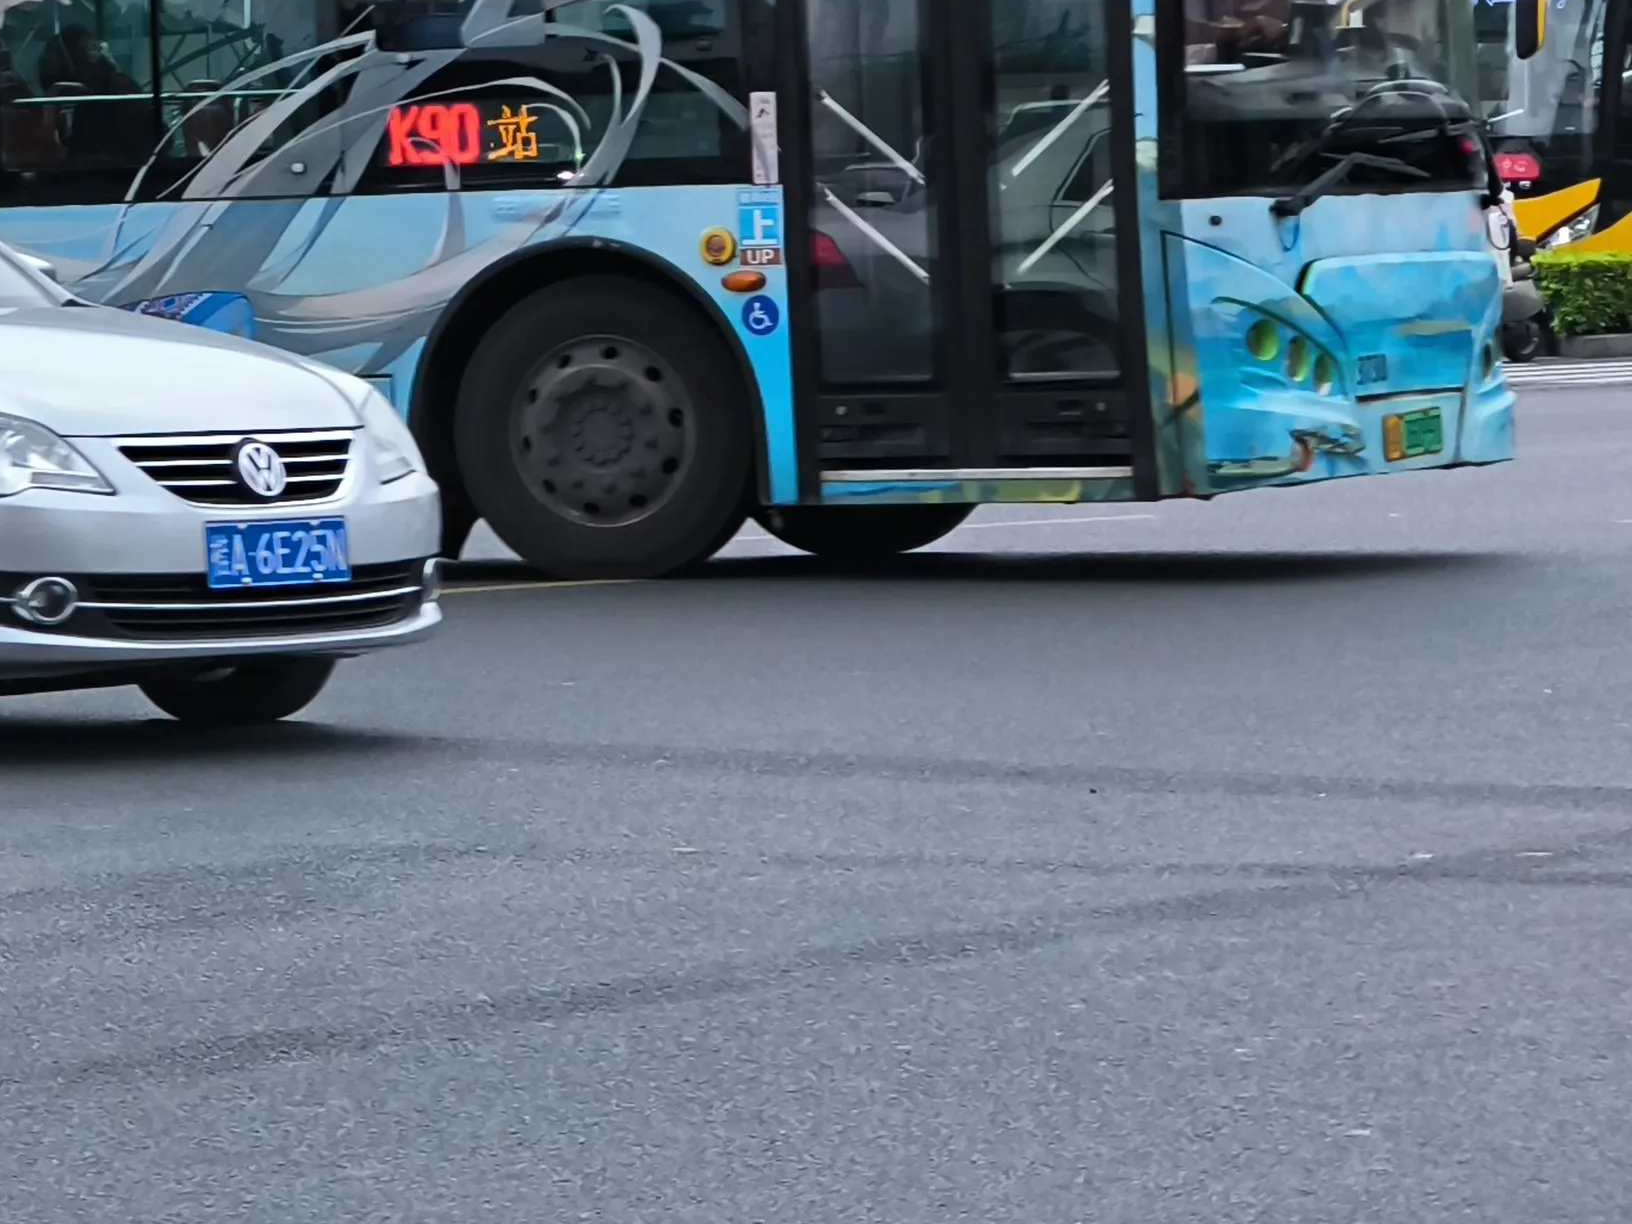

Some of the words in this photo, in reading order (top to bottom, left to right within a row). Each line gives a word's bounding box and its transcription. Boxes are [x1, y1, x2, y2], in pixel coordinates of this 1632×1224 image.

[388, 103, 481, 166] K90
[486, 104, 539, 160] 站
[741, 209, 778, 246] 上
[745, 249, 775, 265] UP
